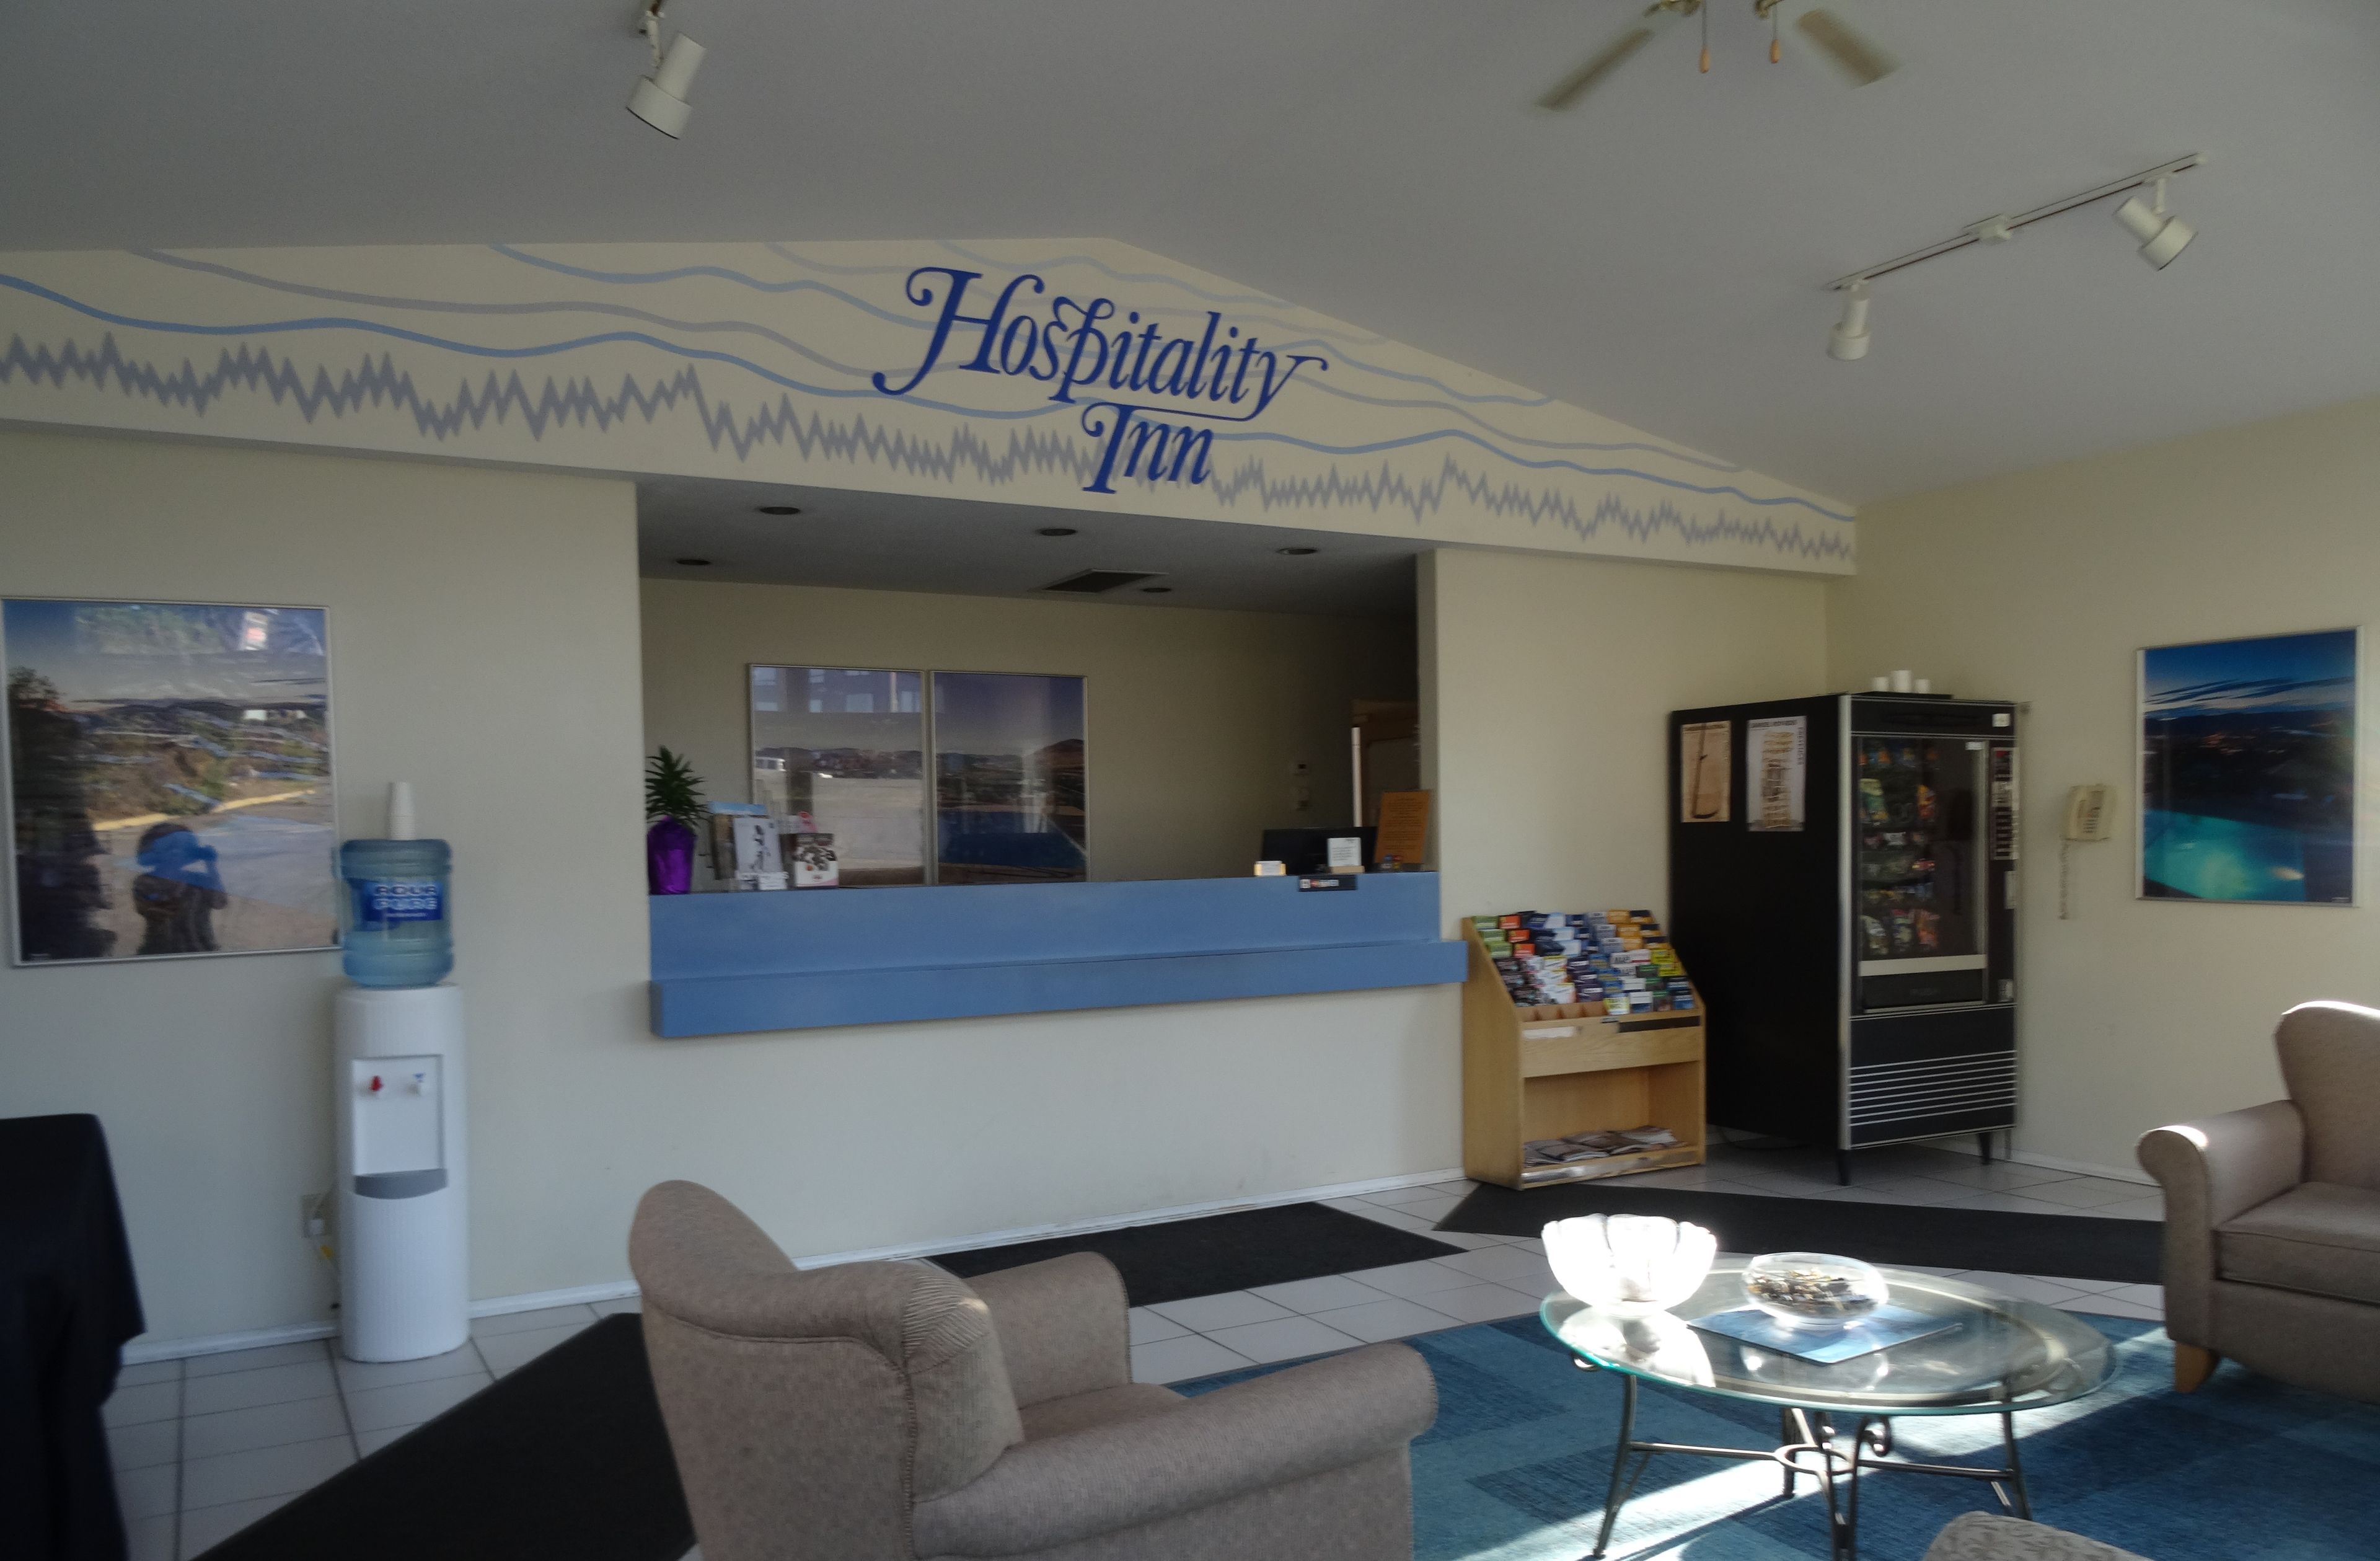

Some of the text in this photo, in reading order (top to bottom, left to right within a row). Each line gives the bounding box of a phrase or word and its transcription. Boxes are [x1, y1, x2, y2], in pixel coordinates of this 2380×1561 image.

[871, 266, 1328, 422] Hospitality
[1081, 401, 1214, 494] Inn
[374, 885, 438, 896] AQUA
